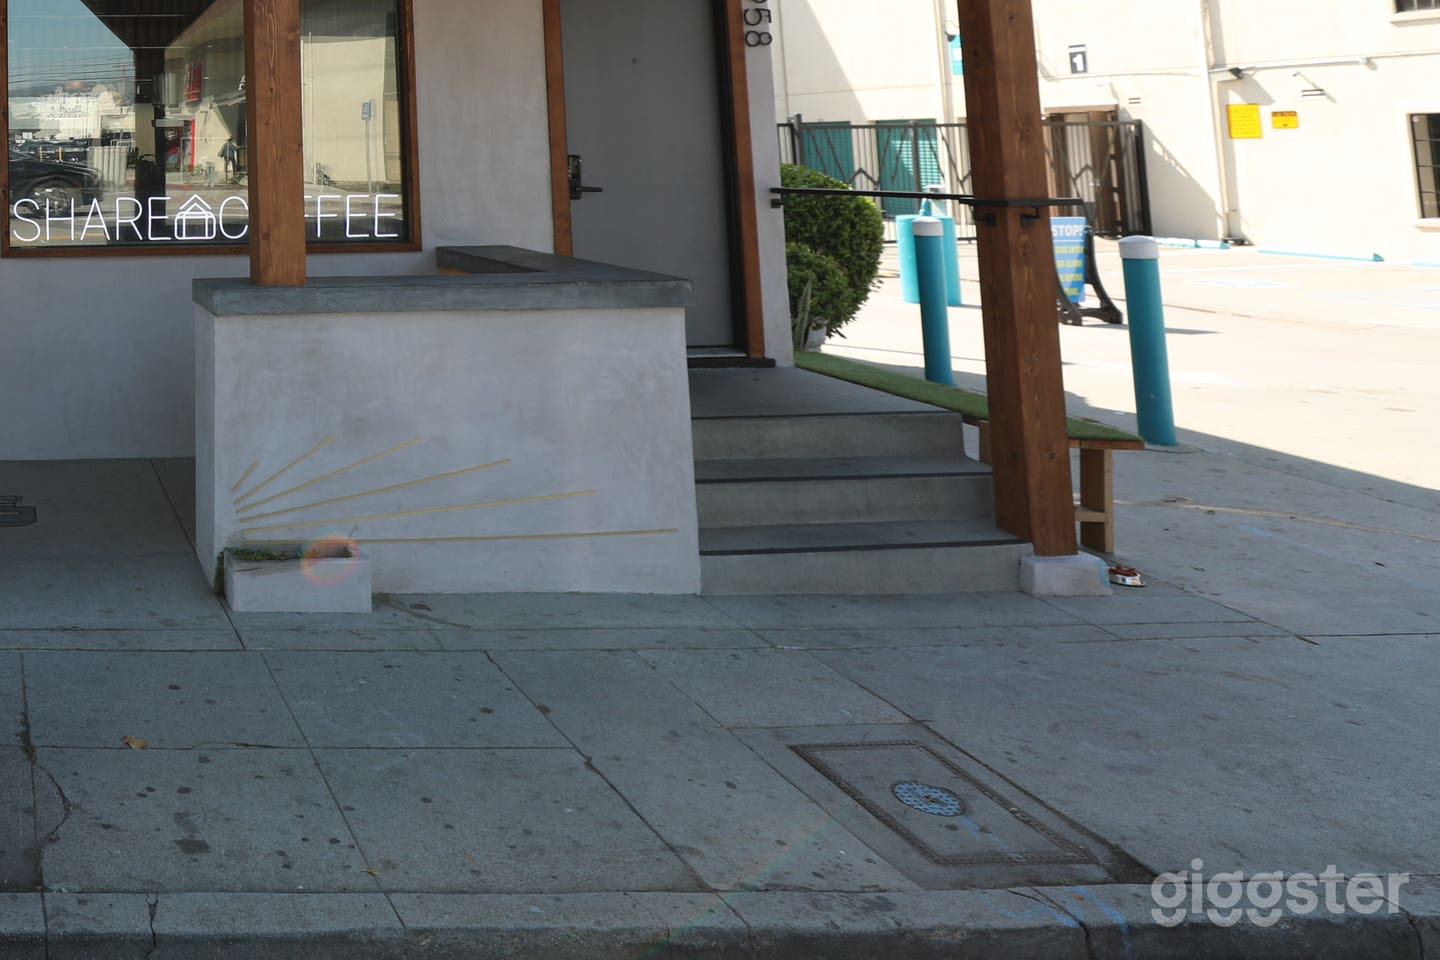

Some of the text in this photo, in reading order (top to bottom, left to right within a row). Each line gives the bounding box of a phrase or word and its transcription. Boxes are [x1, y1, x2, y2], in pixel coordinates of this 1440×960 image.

[1072, 54, 1084, 71] 1
[12, 193, 400, 243] SHARE CFEE
